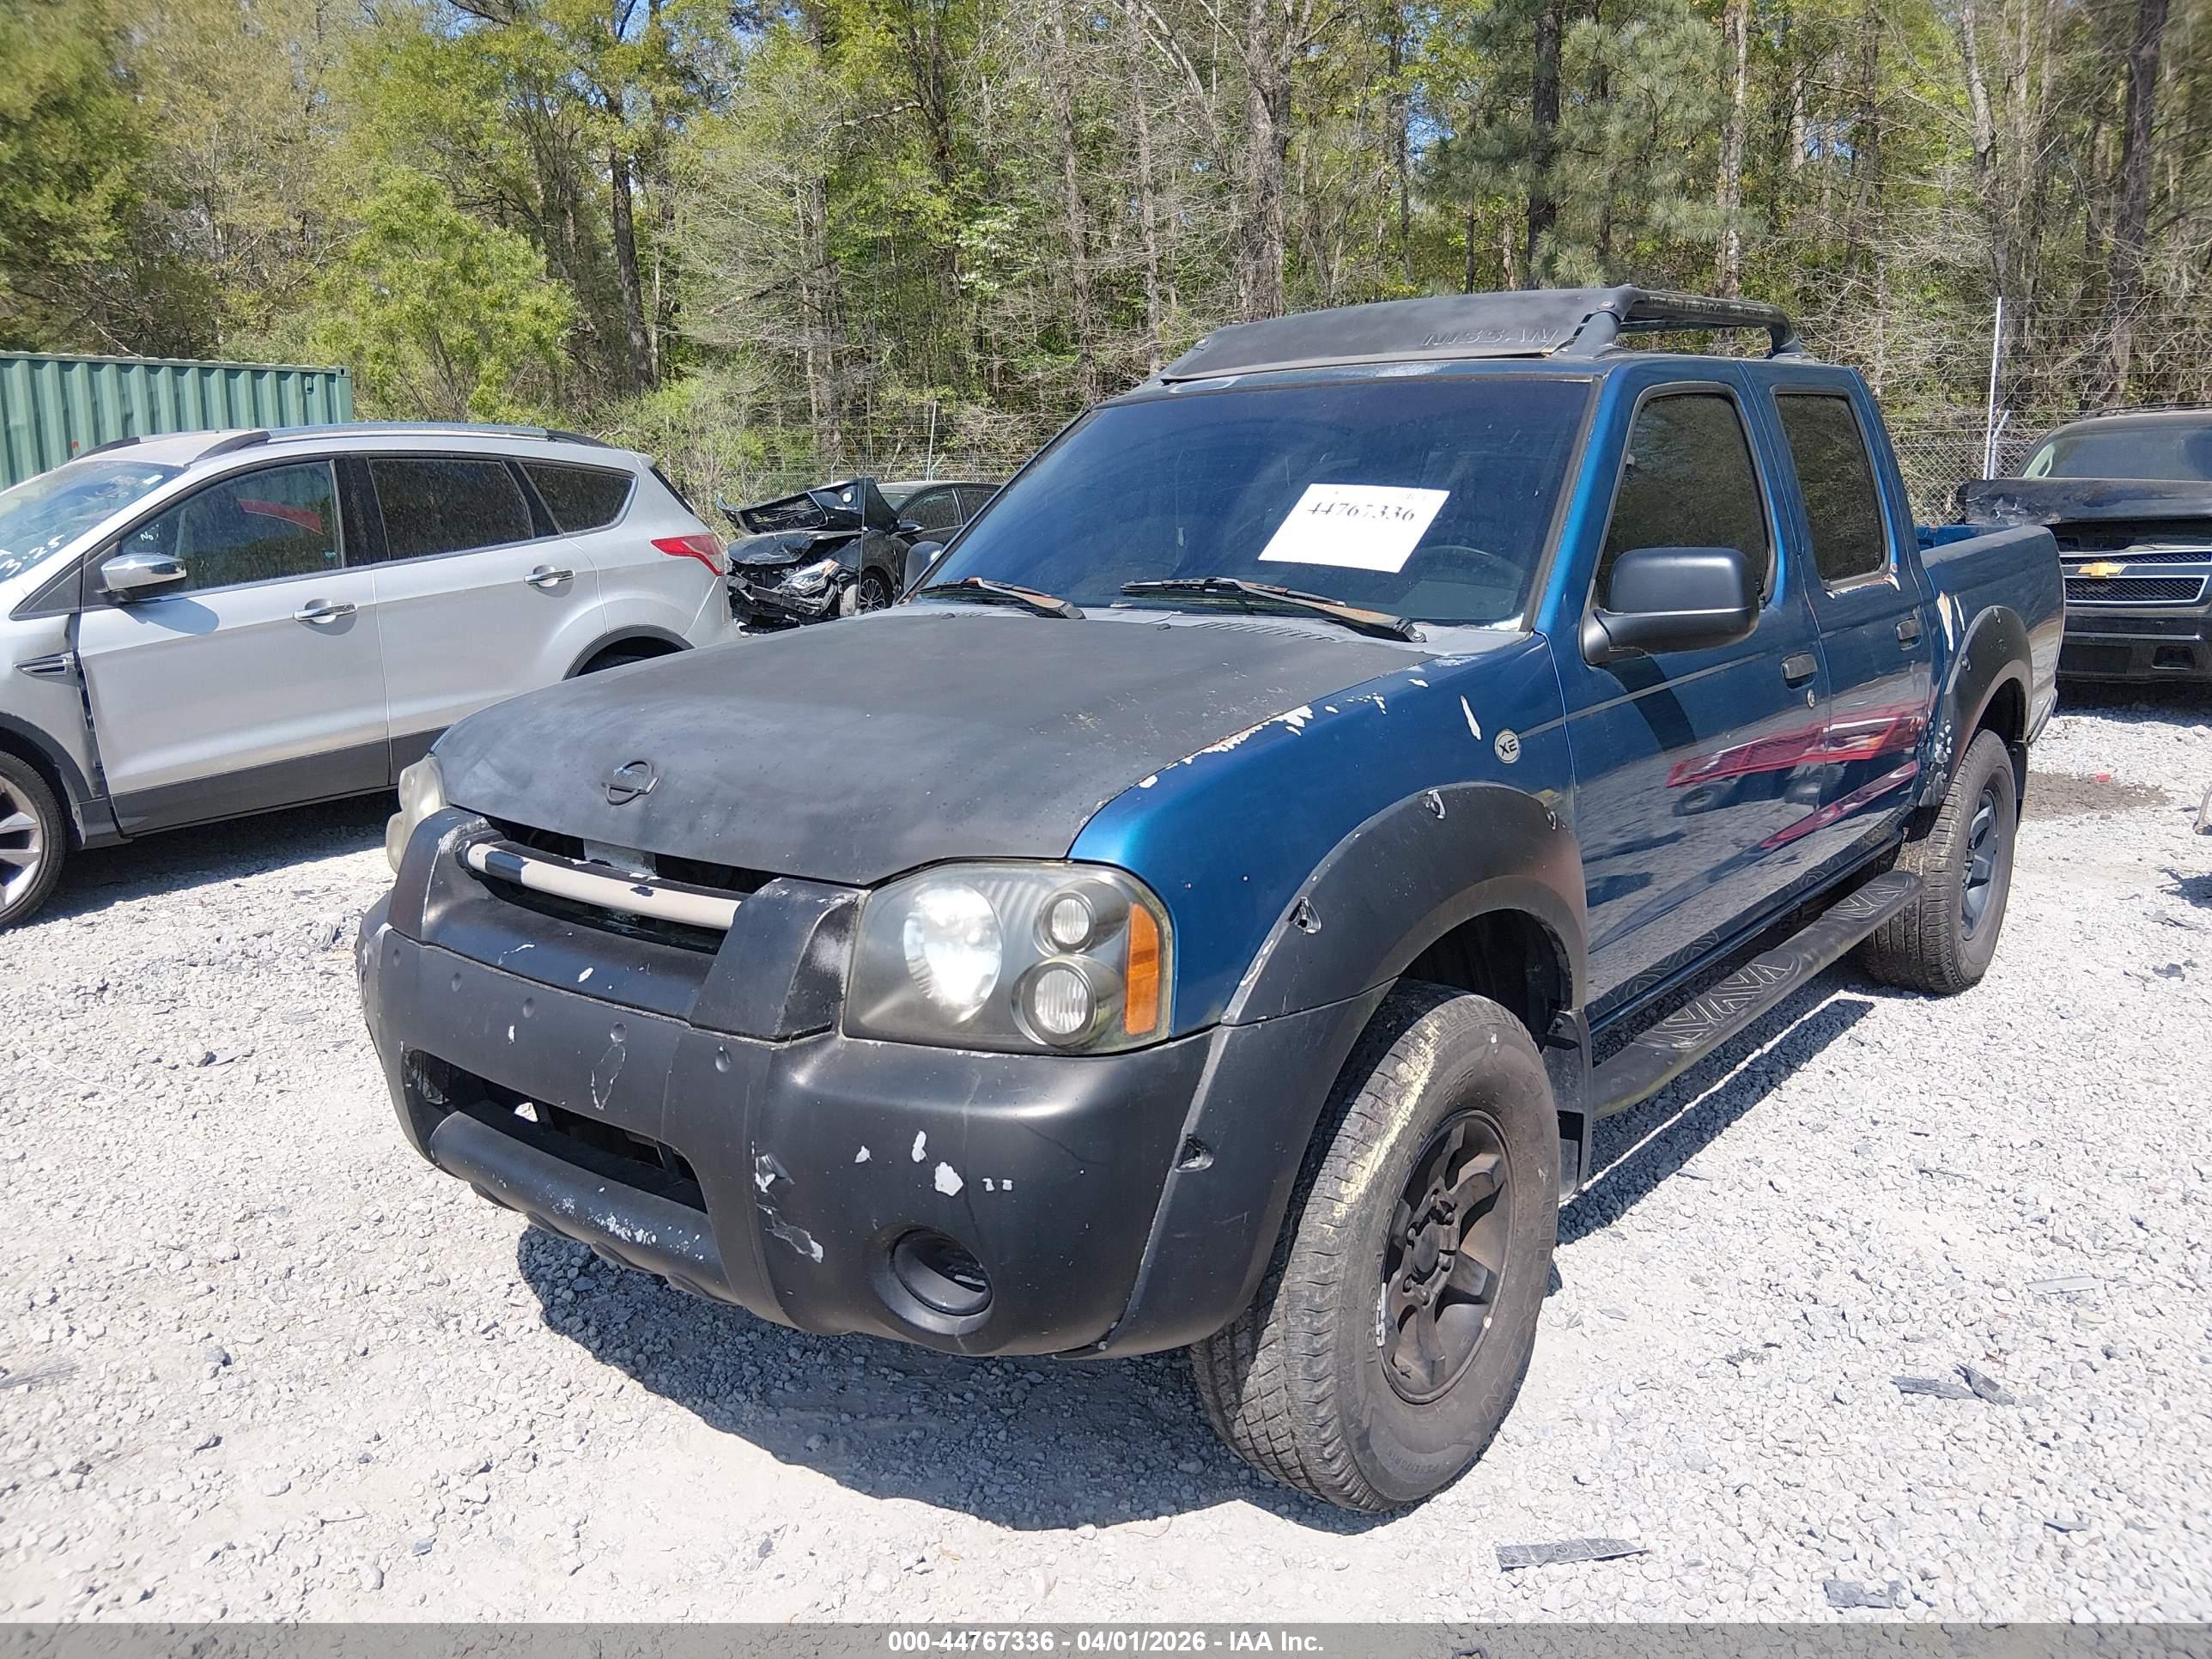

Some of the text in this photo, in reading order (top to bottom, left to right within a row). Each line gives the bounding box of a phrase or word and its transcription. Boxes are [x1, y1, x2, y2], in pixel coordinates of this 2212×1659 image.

[1420, 329, 1559, 347] NISSAN
[1307, 501, 1415, 522] 44767336
[1498, 738, 1518, 757] XE
